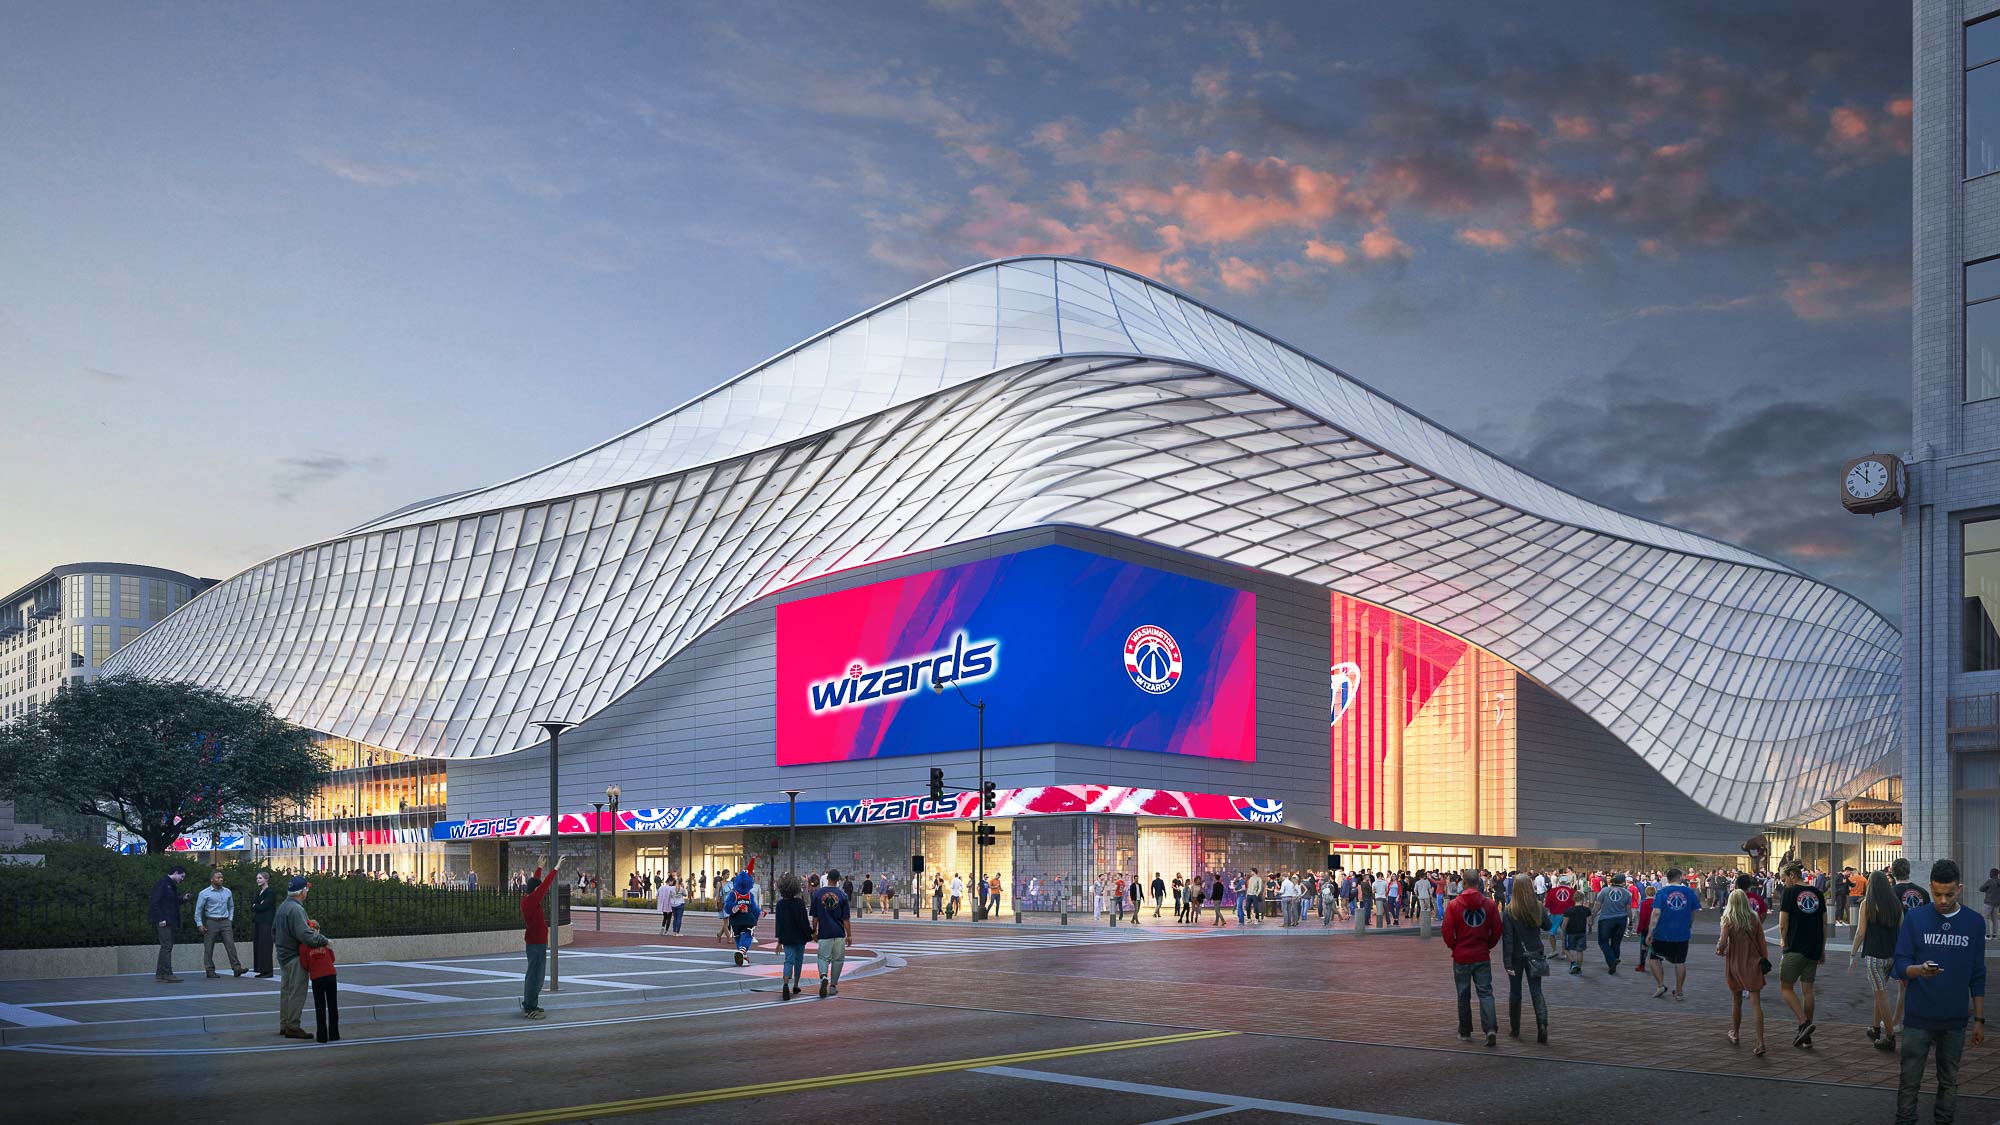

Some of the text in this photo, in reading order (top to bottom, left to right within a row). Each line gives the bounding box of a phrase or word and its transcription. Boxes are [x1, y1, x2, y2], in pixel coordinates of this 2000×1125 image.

[1131, 628, 1175, 650] WASHINGTON
[1136, 675, 1172, 692] WIZARDS
[634, 807, 680, 830] WIZARDS
[1923, 933, 1969, 947] WIZARDS
